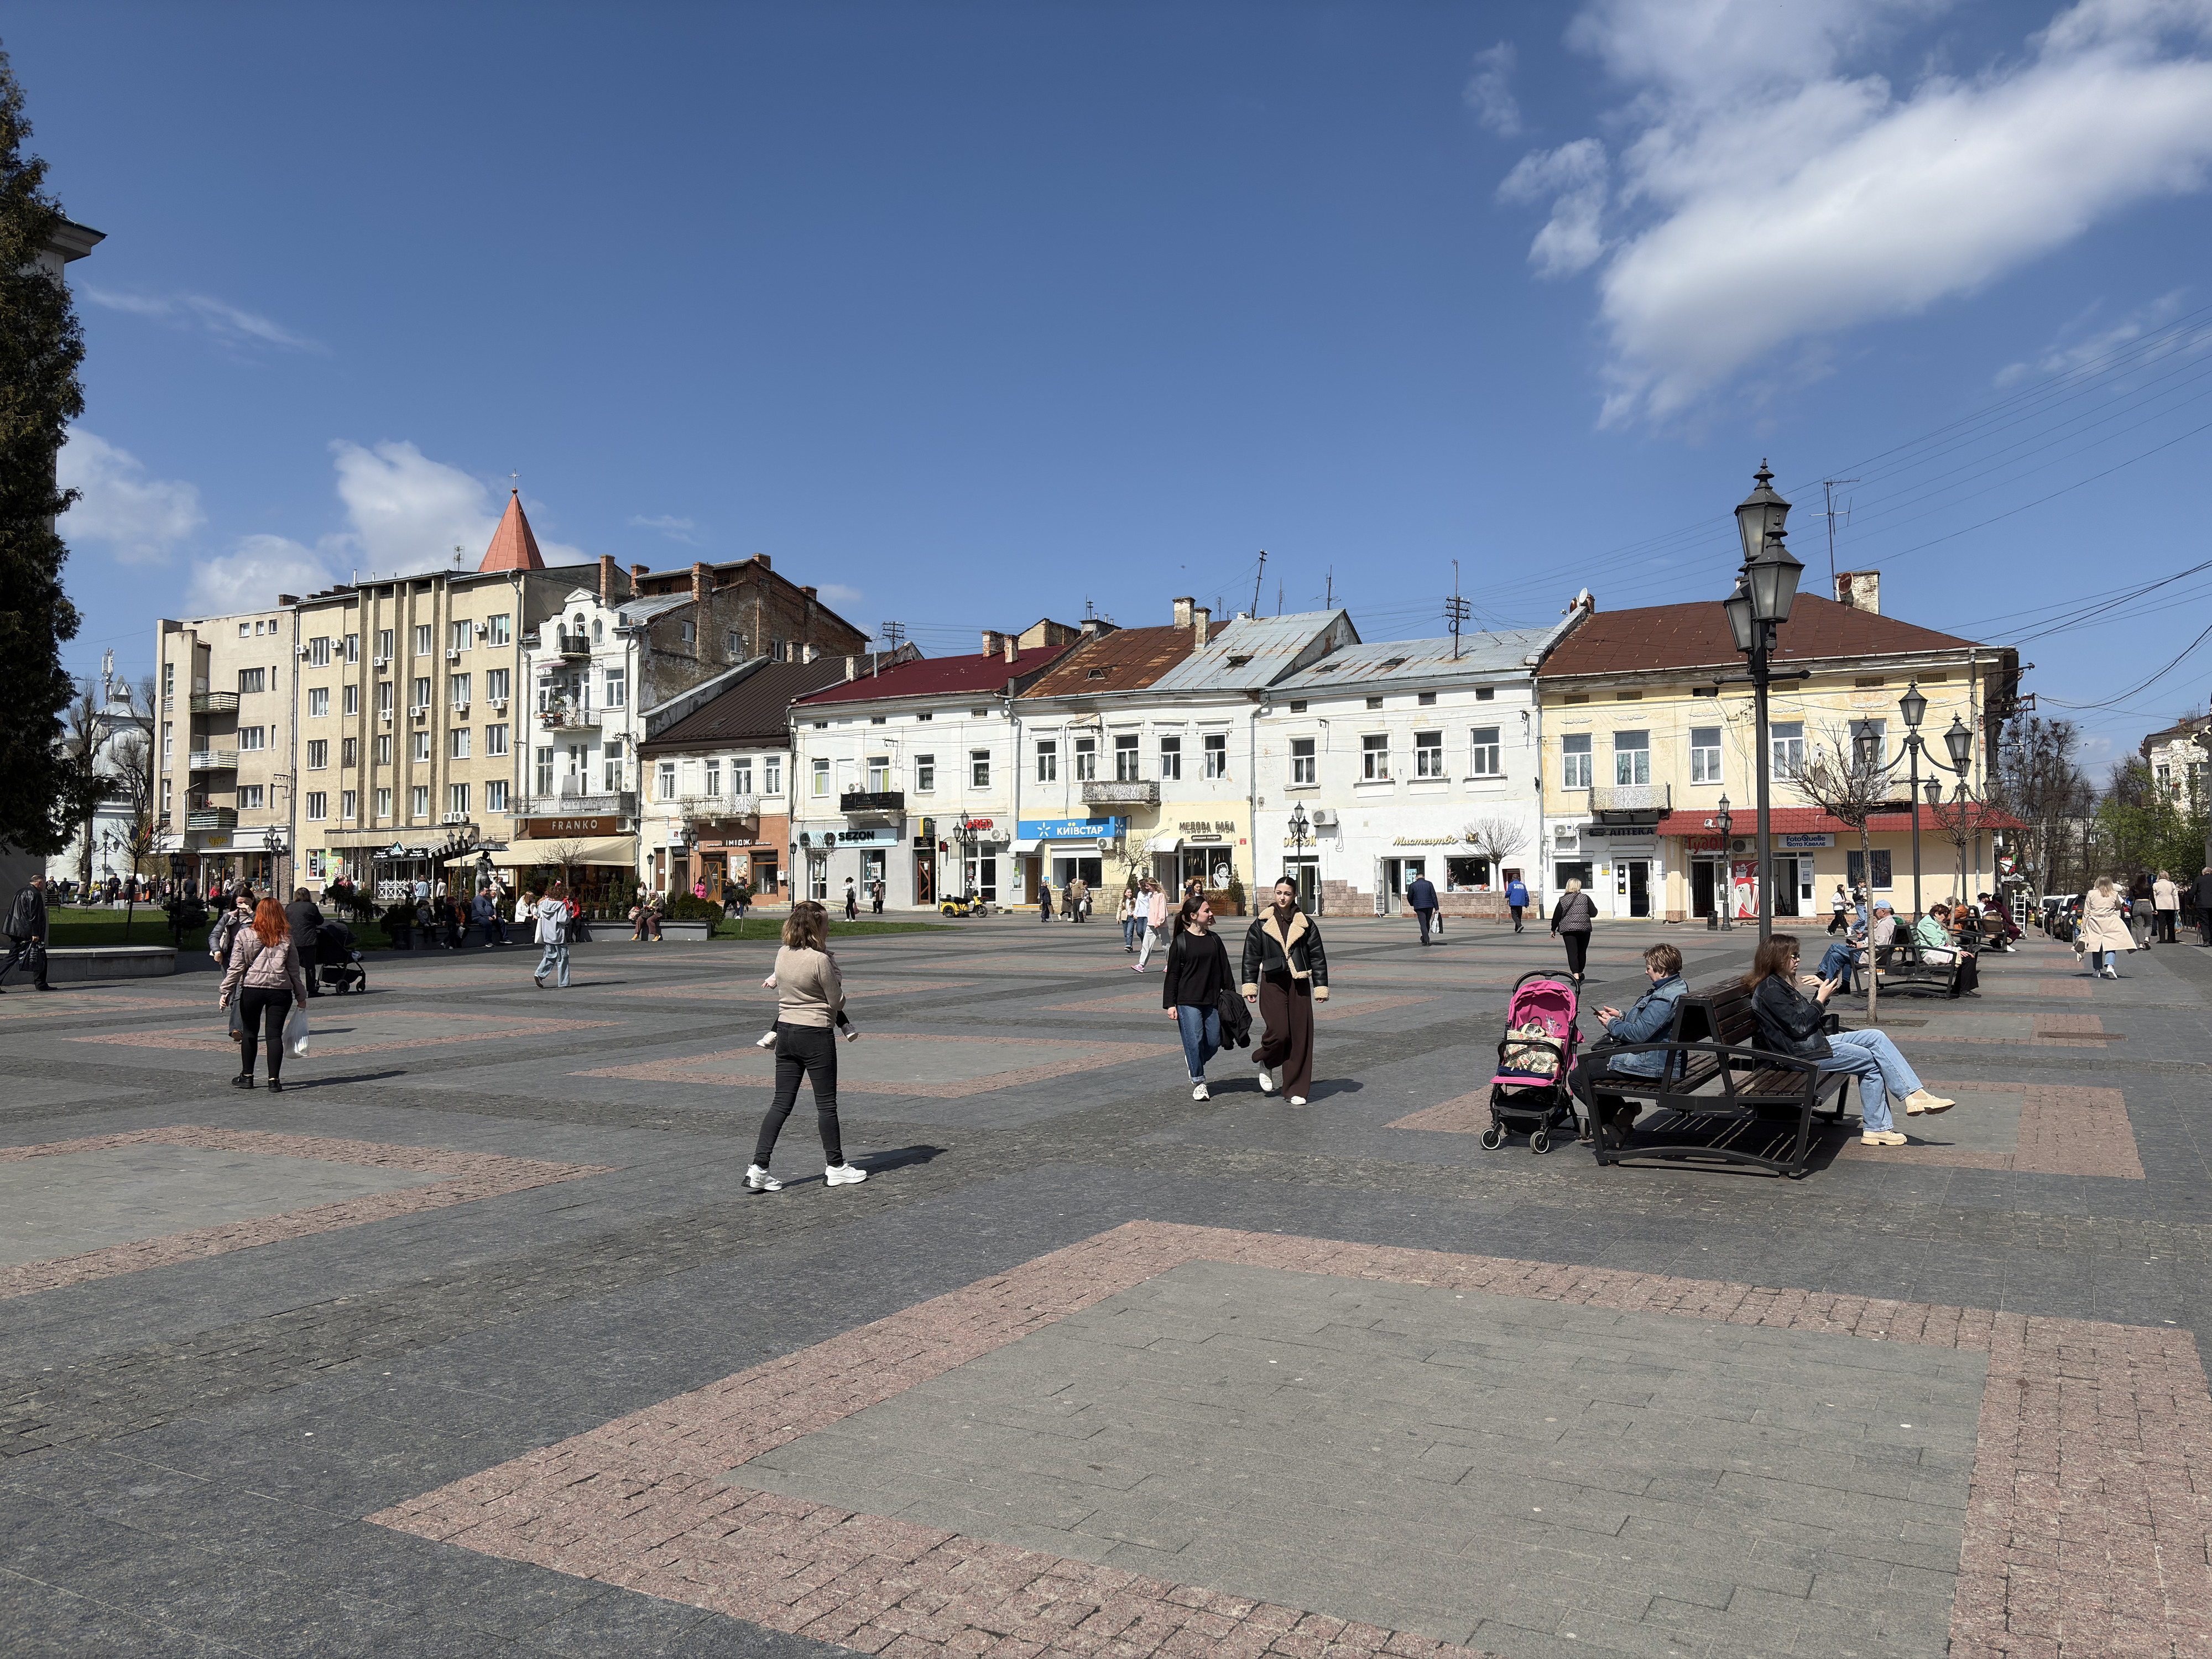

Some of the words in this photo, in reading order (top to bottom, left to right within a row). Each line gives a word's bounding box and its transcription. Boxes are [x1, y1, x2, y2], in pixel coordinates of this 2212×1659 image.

[552, 819, 597, 830] FRANKO
[973, 818, 993, 829] RED
[1057, 822, 1103, 835] КИЇВСТАР
[1179, 822, 1211, 832] МЕДОВА
[1215, 821, 1235, 832] БАБА
[838, 831, 875, 841] SEZON
[1393, 835, 1458, 845] Мистецтво
